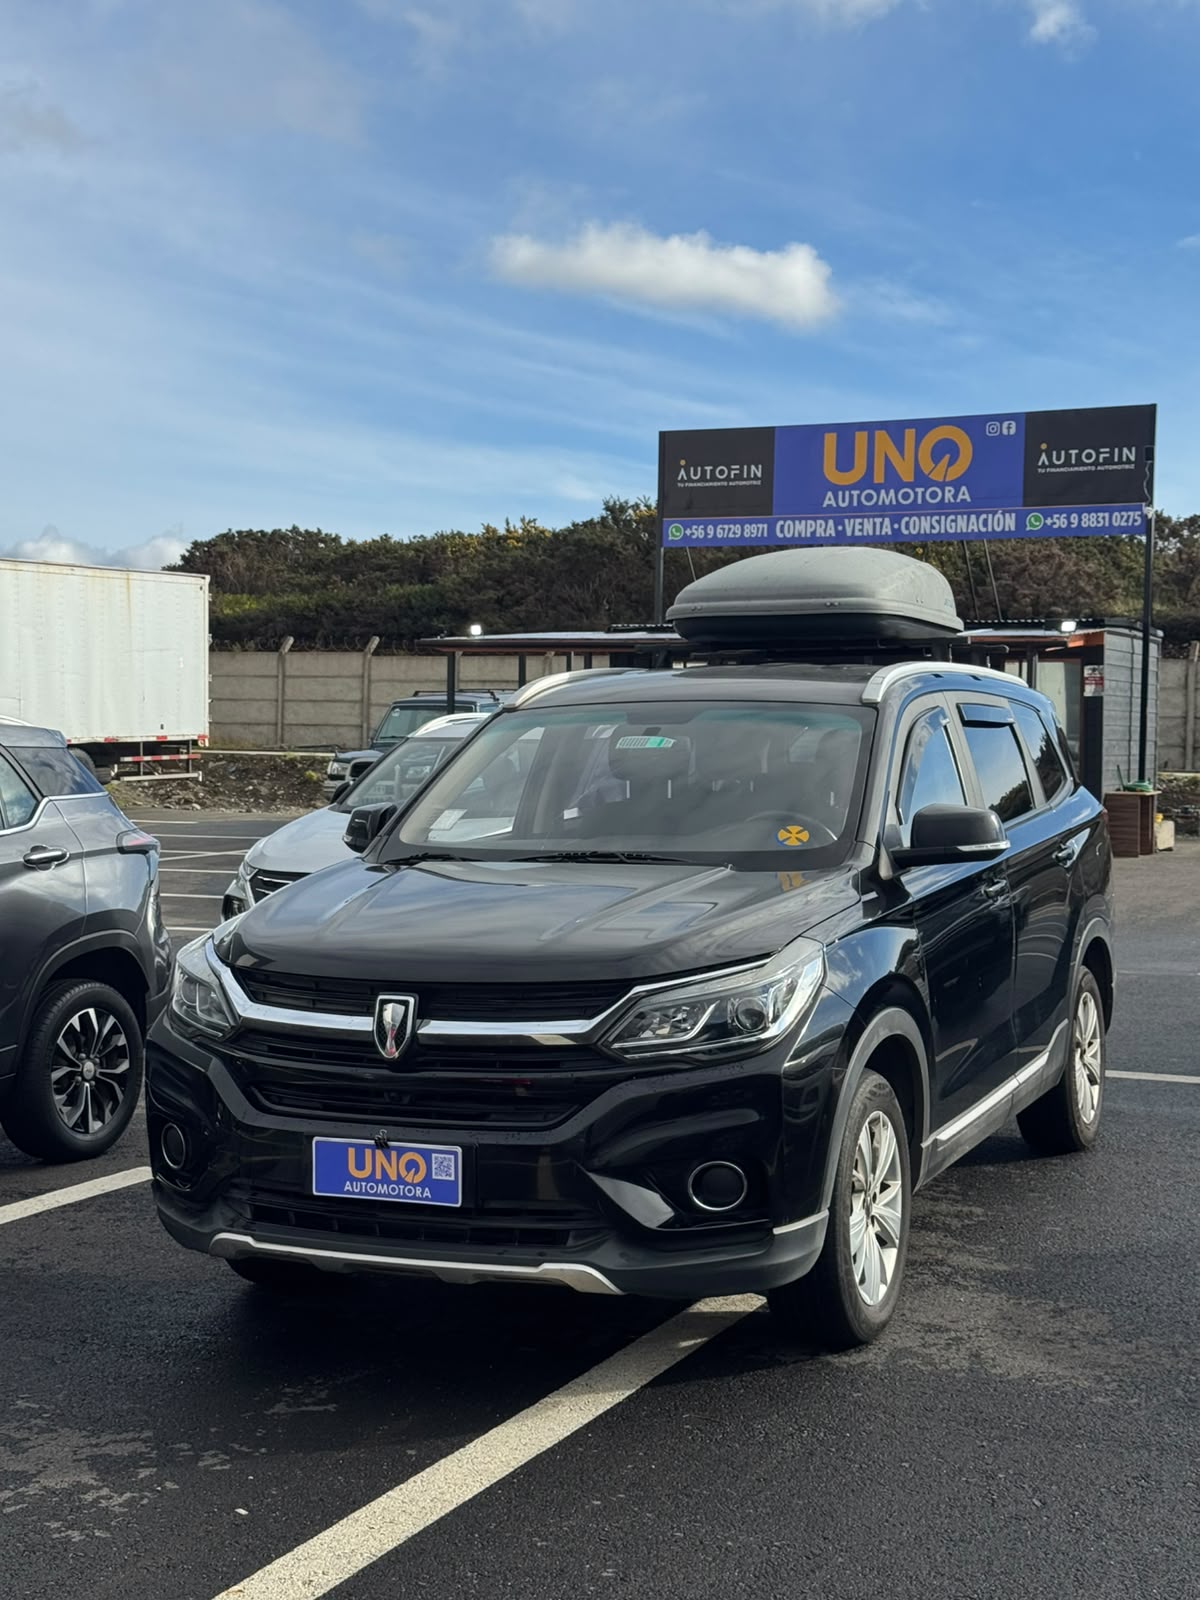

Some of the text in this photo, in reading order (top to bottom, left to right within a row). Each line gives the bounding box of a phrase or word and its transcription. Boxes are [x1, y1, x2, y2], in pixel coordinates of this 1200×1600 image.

[823, 425, 973, 485] UNO
[1037, 446, 1136, 466] AUTOFIN
[677, 463, 763, 480] AUTOFIN
[822, 485, 972, 508] AUTOMOTORA
[775, 510, 1016, 538] COMPRA VENTA CONSIGNACIÓN
[1045, 511, 1142, 528] +56 9 8831 0275
[685, 523, 768, 539] +56 9 6729 8971
[348, 1147, 426, 1184] UNO
[344, 1180, 432, 1199] AUTOMOTORA
